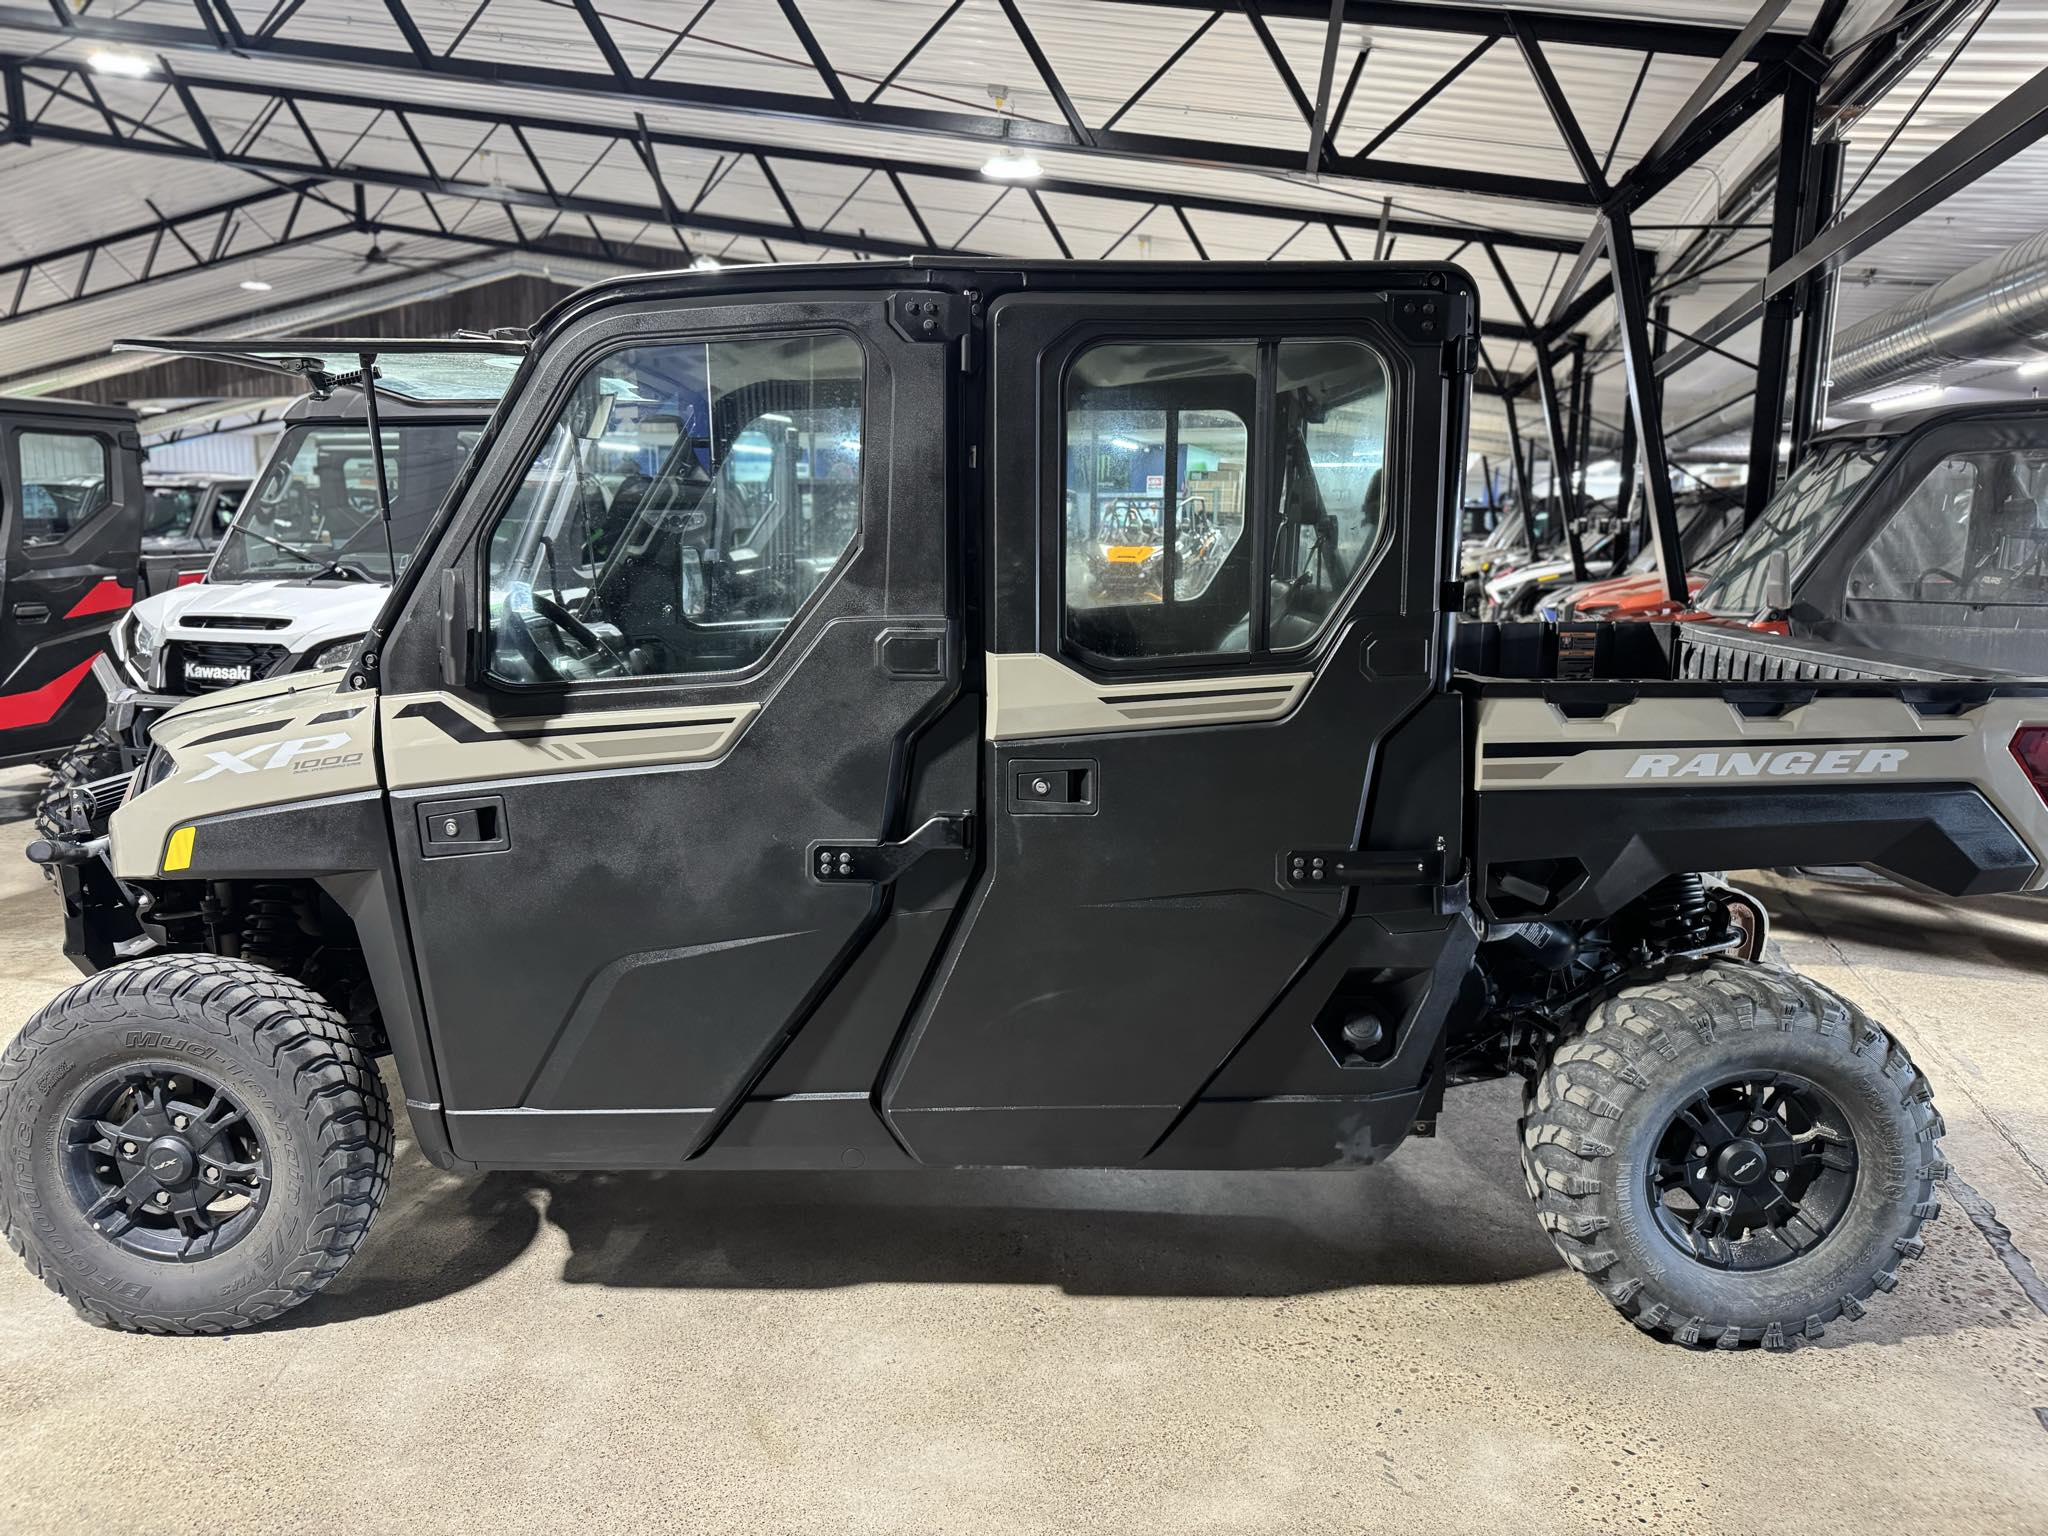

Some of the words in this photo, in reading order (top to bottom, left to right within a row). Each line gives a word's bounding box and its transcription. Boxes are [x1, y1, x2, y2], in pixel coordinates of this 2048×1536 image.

[185, 663, 252, 681] Kawasaki
[184, 732, 353, 785] XP
[293, 753, 363, 770] 1000
[1624, 749, 1909, 778] RANGER
[125, 1030, 304, 1207] Mud-Terrain
[14, 1096, 153, 1301] BFGoodrich
